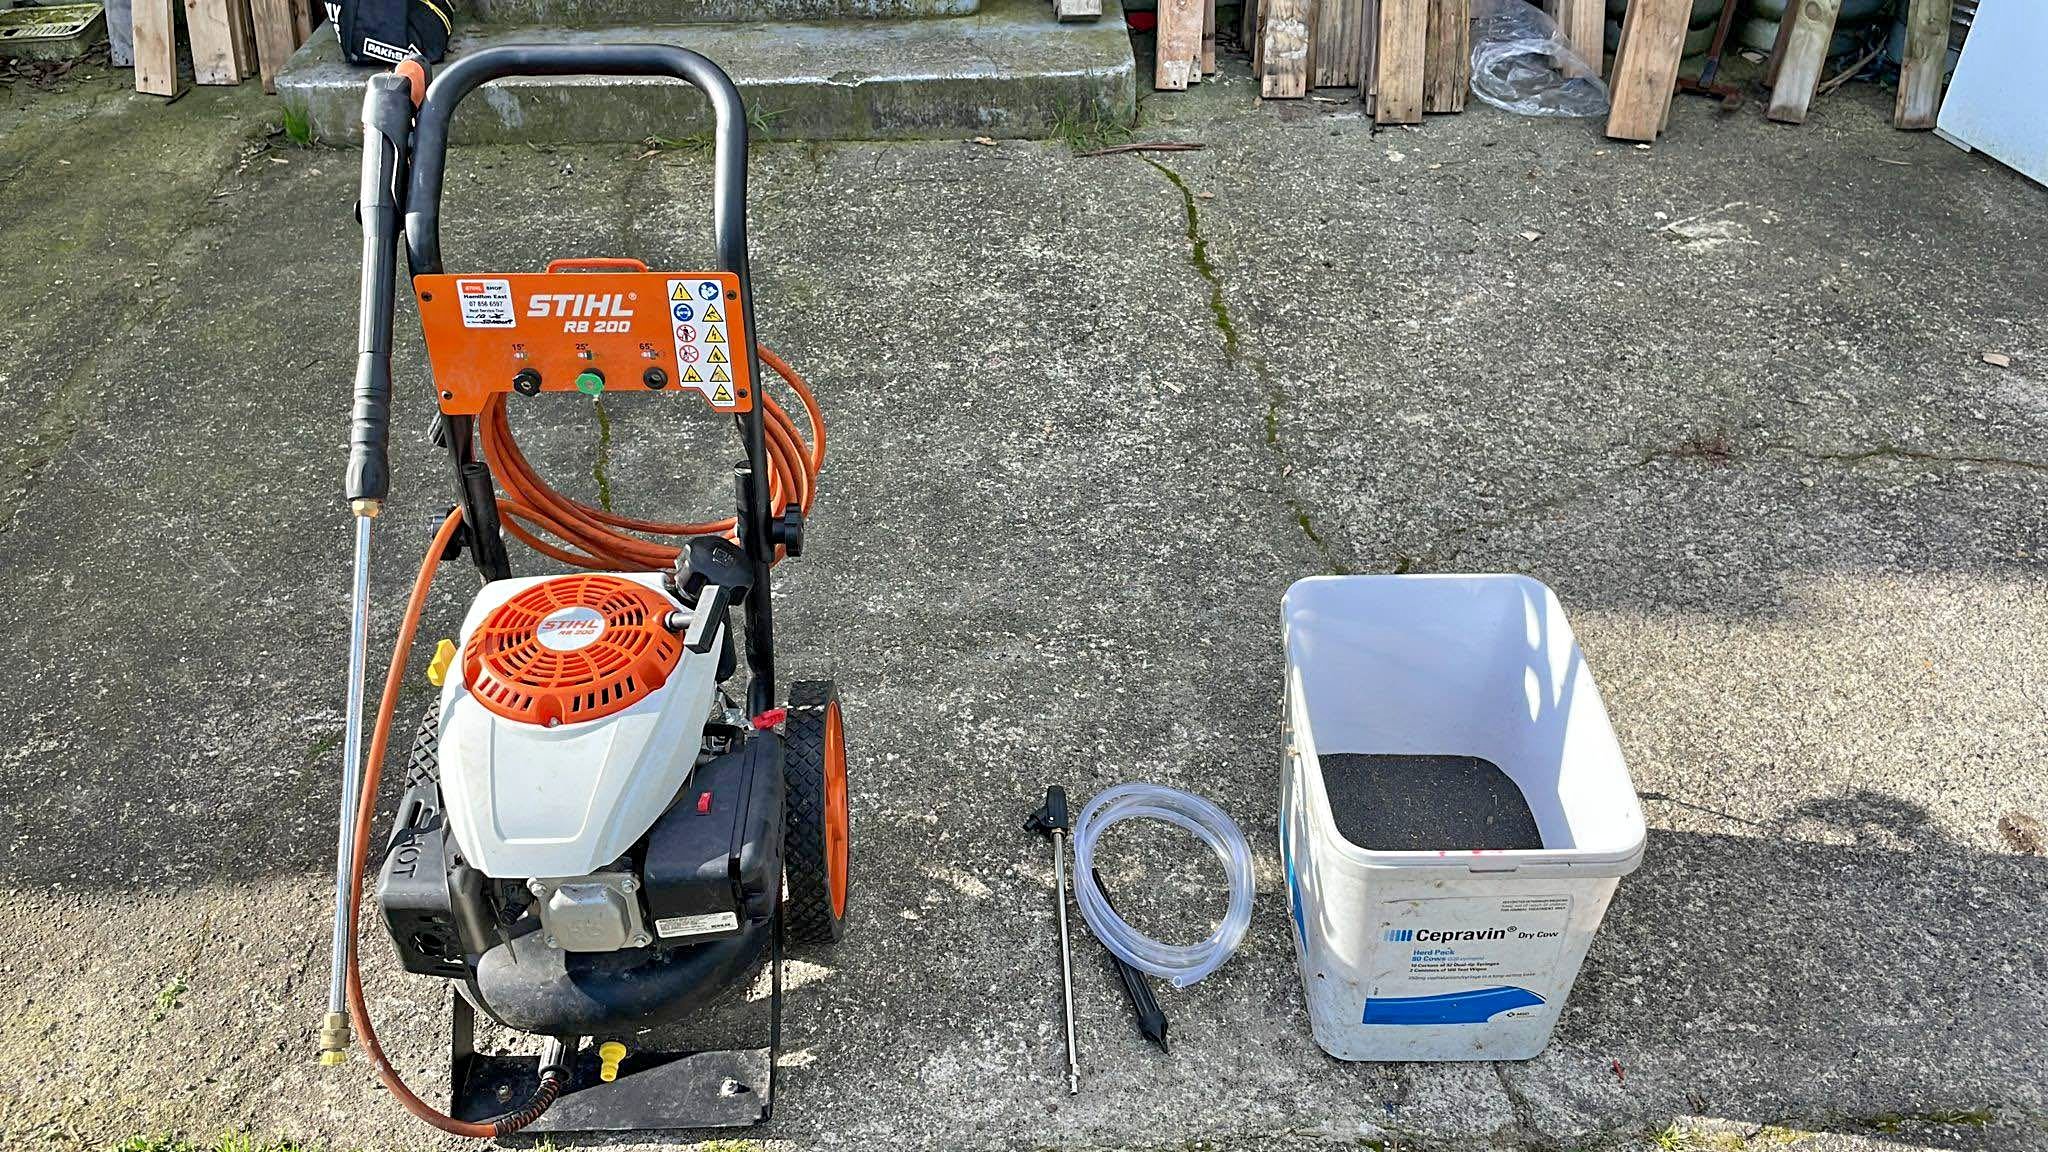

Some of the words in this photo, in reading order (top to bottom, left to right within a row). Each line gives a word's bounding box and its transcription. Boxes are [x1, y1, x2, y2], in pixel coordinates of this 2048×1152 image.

[563, 320, 590, 333] RB
[593, 320, 631, 333] 200
[542, 620, 598, 630] STIHL
